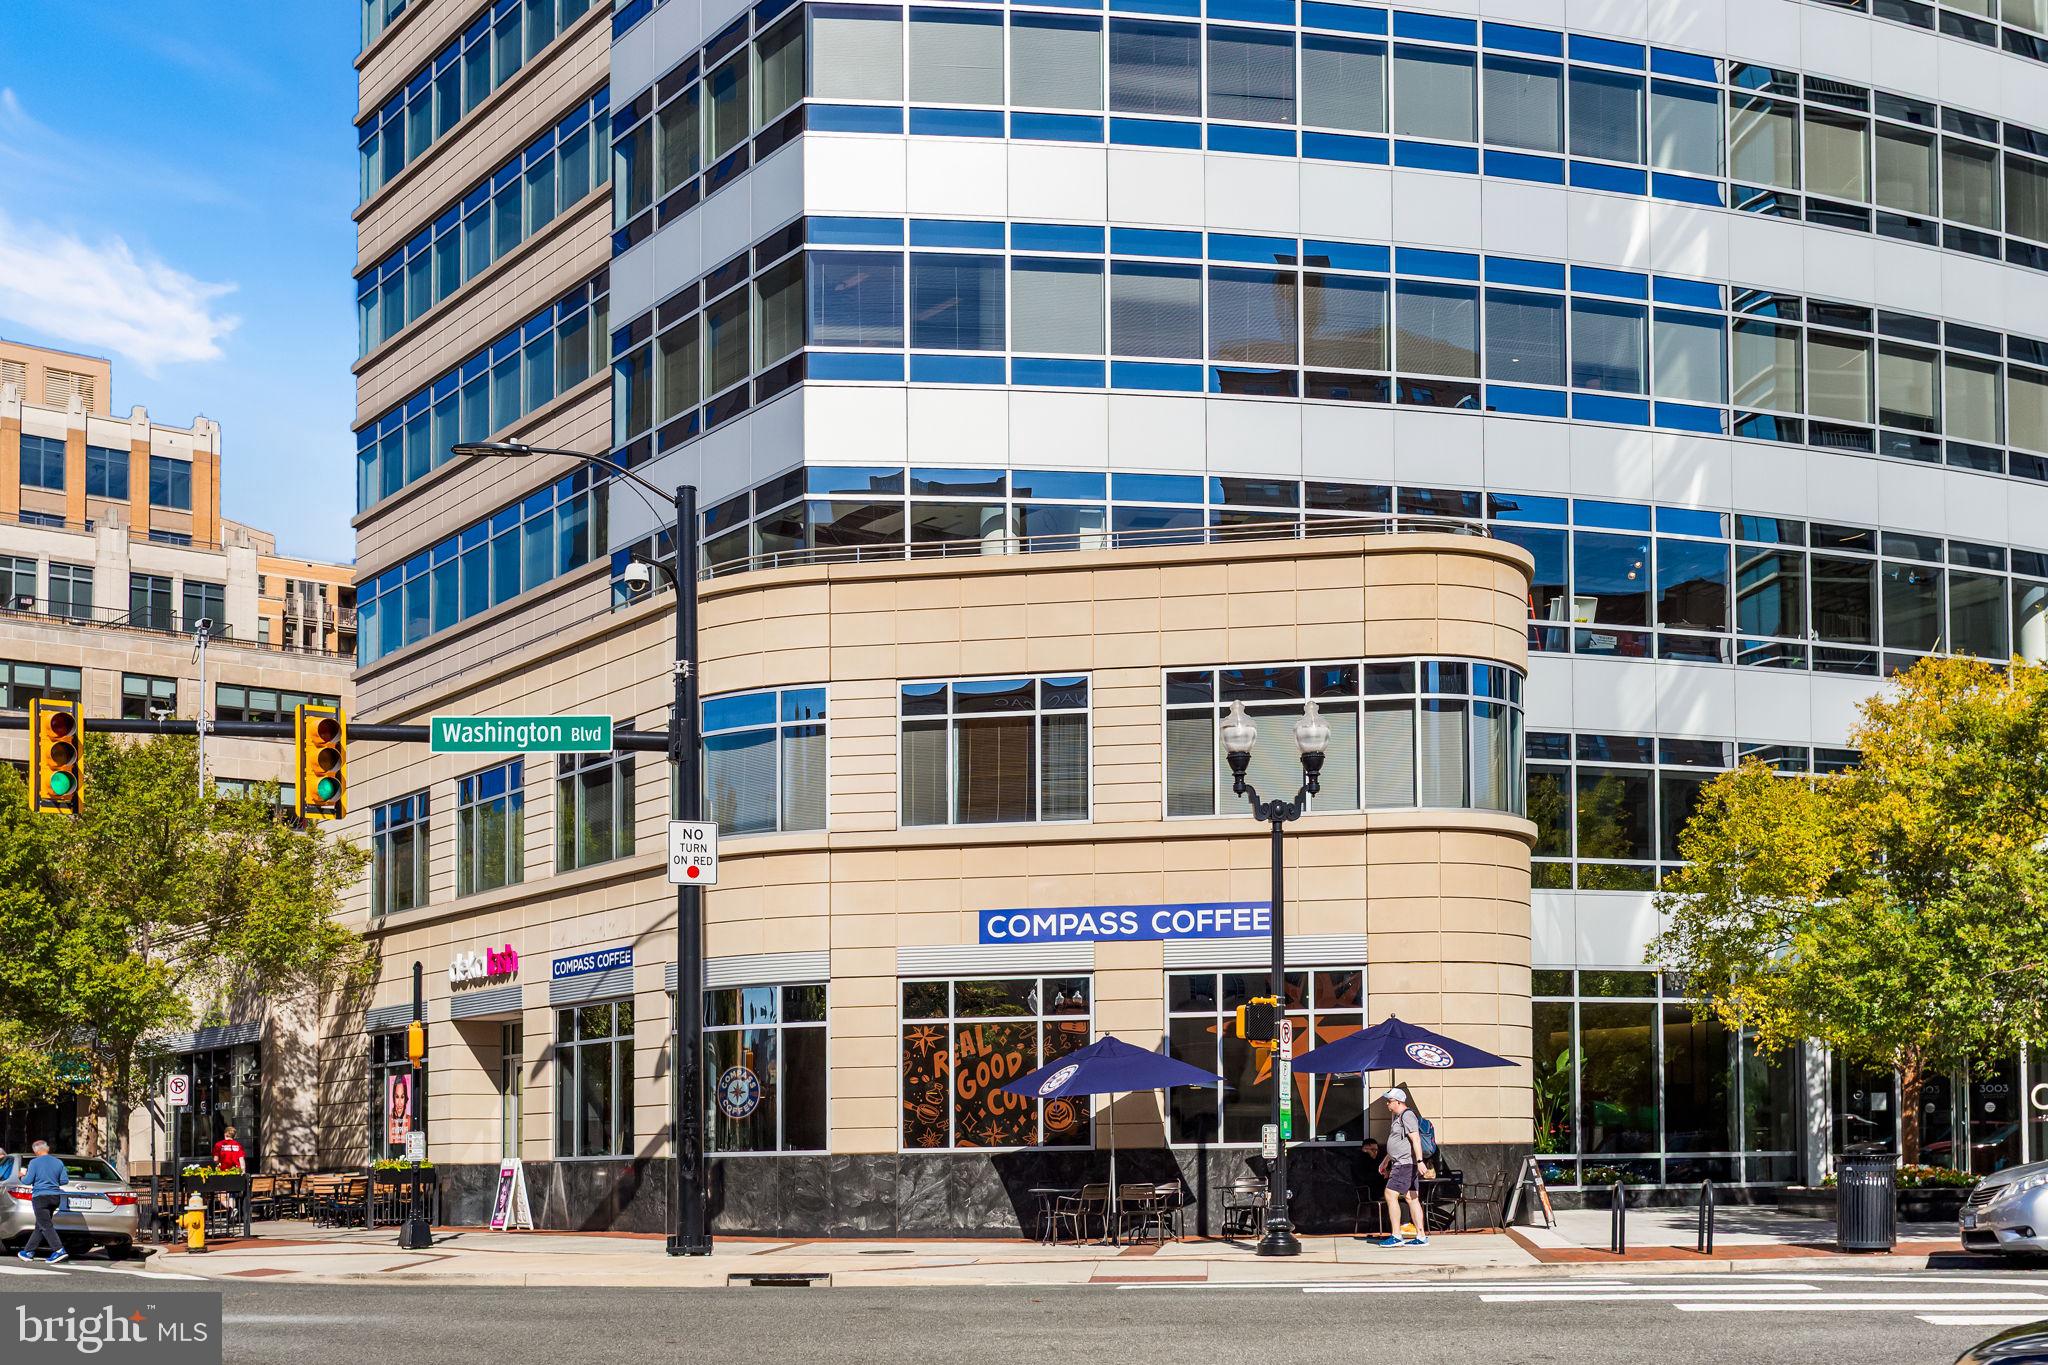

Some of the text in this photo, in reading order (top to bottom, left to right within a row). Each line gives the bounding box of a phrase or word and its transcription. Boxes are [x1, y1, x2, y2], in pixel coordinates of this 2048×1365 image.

[442, 721, 601, 748] Washington Blvd
[683, 828, 704, 840] NO
[680, 843, 708, 853] TURN
[673, 855, 713, 866] ON RED
[987, 908, 1271, 938] COMPASS COFFEE
[554, 949, 632, 976] COMPASS COFFEE
[721, 1069, 756, 1089] COMPASS
[957, 1051, 1023, 1100] GOOD
[1979, 1084, 2009, 1093] 3003
[722, 1099, 755, 1114] COFFEE
